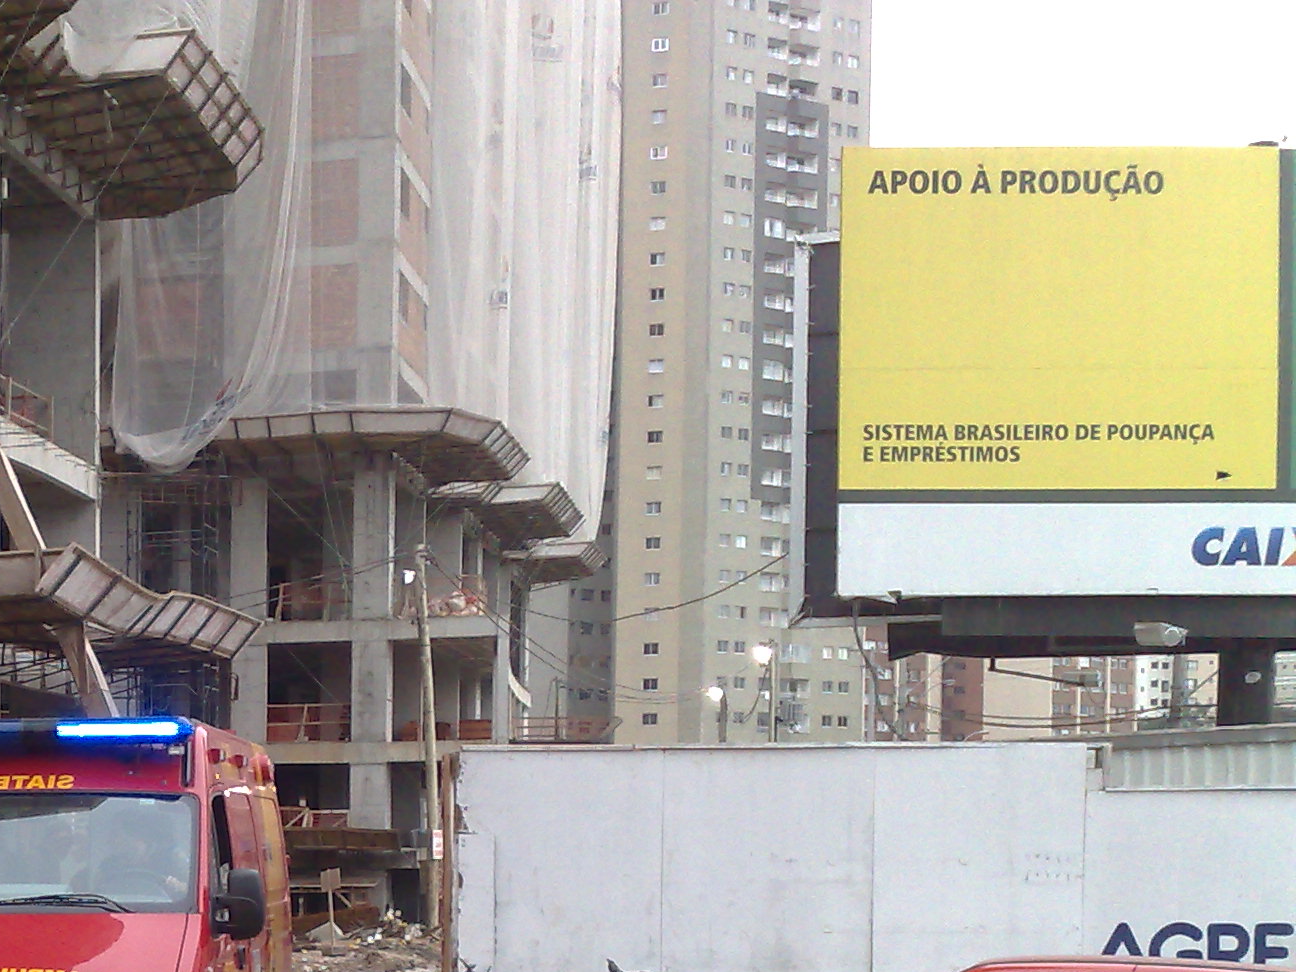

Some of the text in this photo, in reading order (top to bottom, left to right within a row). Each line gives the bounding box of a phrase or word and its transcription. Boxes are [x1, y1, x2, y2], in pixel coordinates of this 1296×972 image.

[867, 163, 1164, 202] APOIO À PRODUÇÃO
[862, 423, 1215, 445] SISTEMA BRASILEIRO DE POUPANÇA
[862, 440, 1021, 463] E EMPRÉSTIMOS
